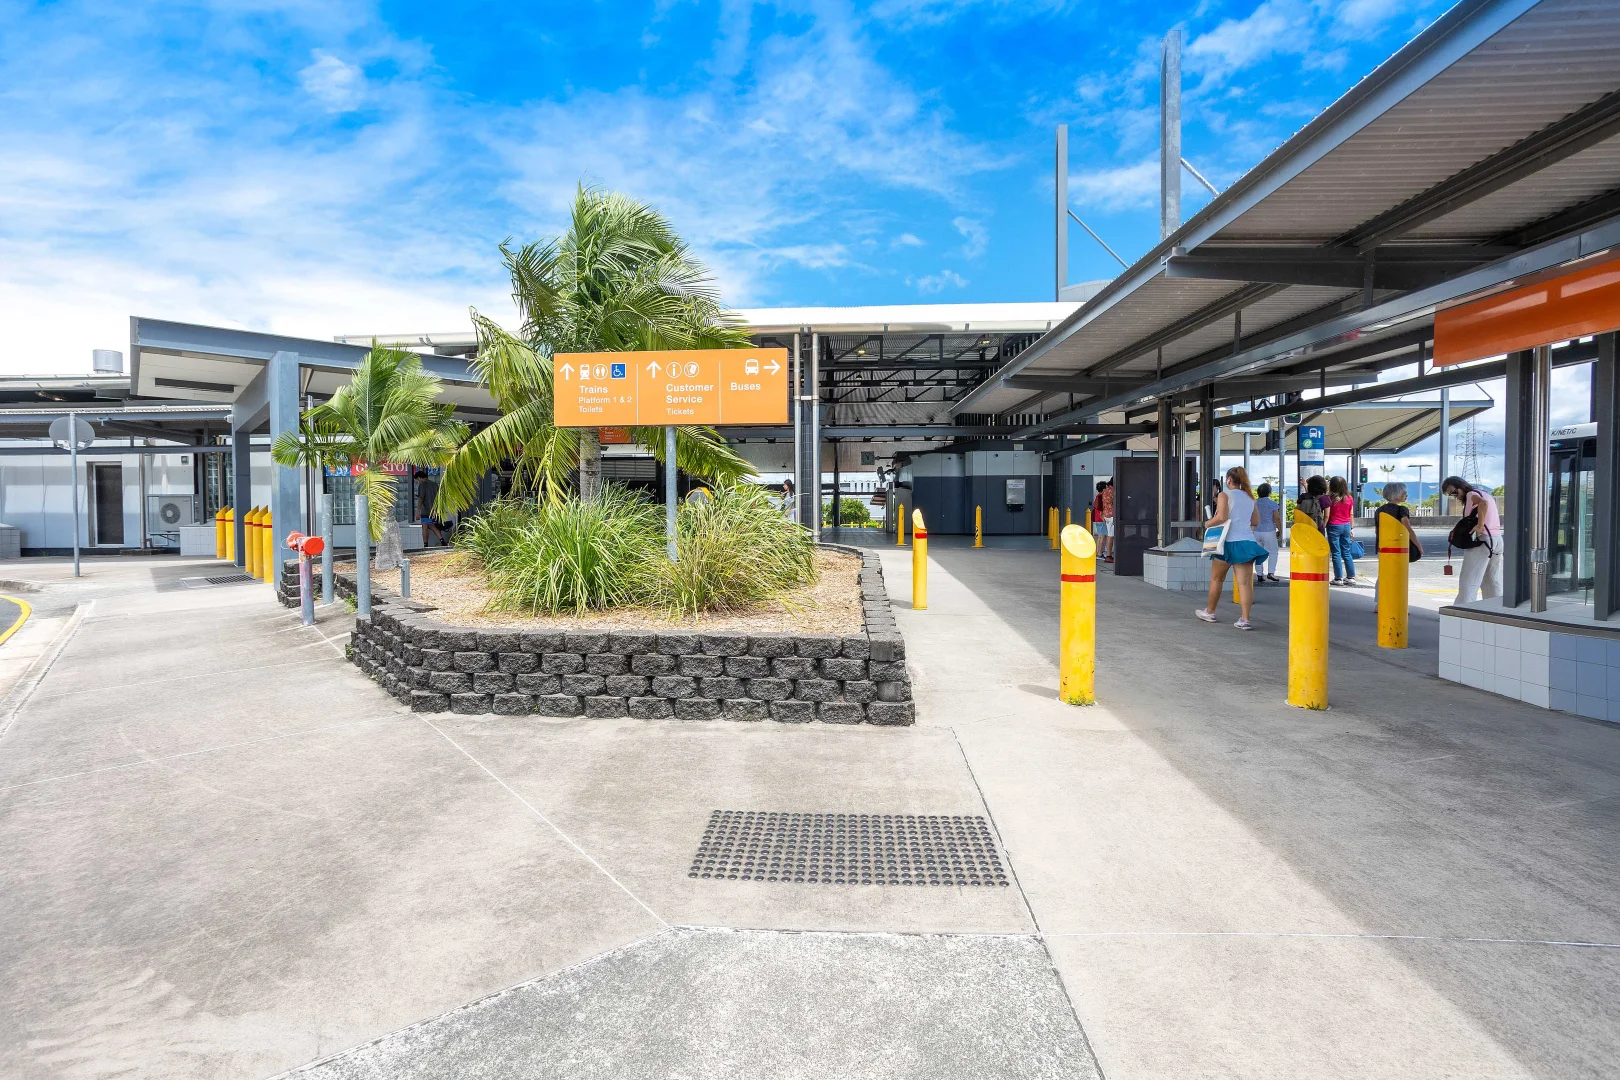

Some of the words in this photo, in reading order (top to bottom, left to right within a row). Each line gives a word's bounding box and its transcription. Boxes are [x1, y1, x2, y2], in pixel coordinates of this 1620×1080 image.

[579, 385, 608, 394] Trains
[666, 383, 714, 392] Customer
[730, 381, 761, 391] Buses
[578, 396, 610, 404] Platform
[666, 395, 703, 404] Service
[578, 405, 603, 413] Toilets
[1551, 428, 1577, 436] KINETIC
